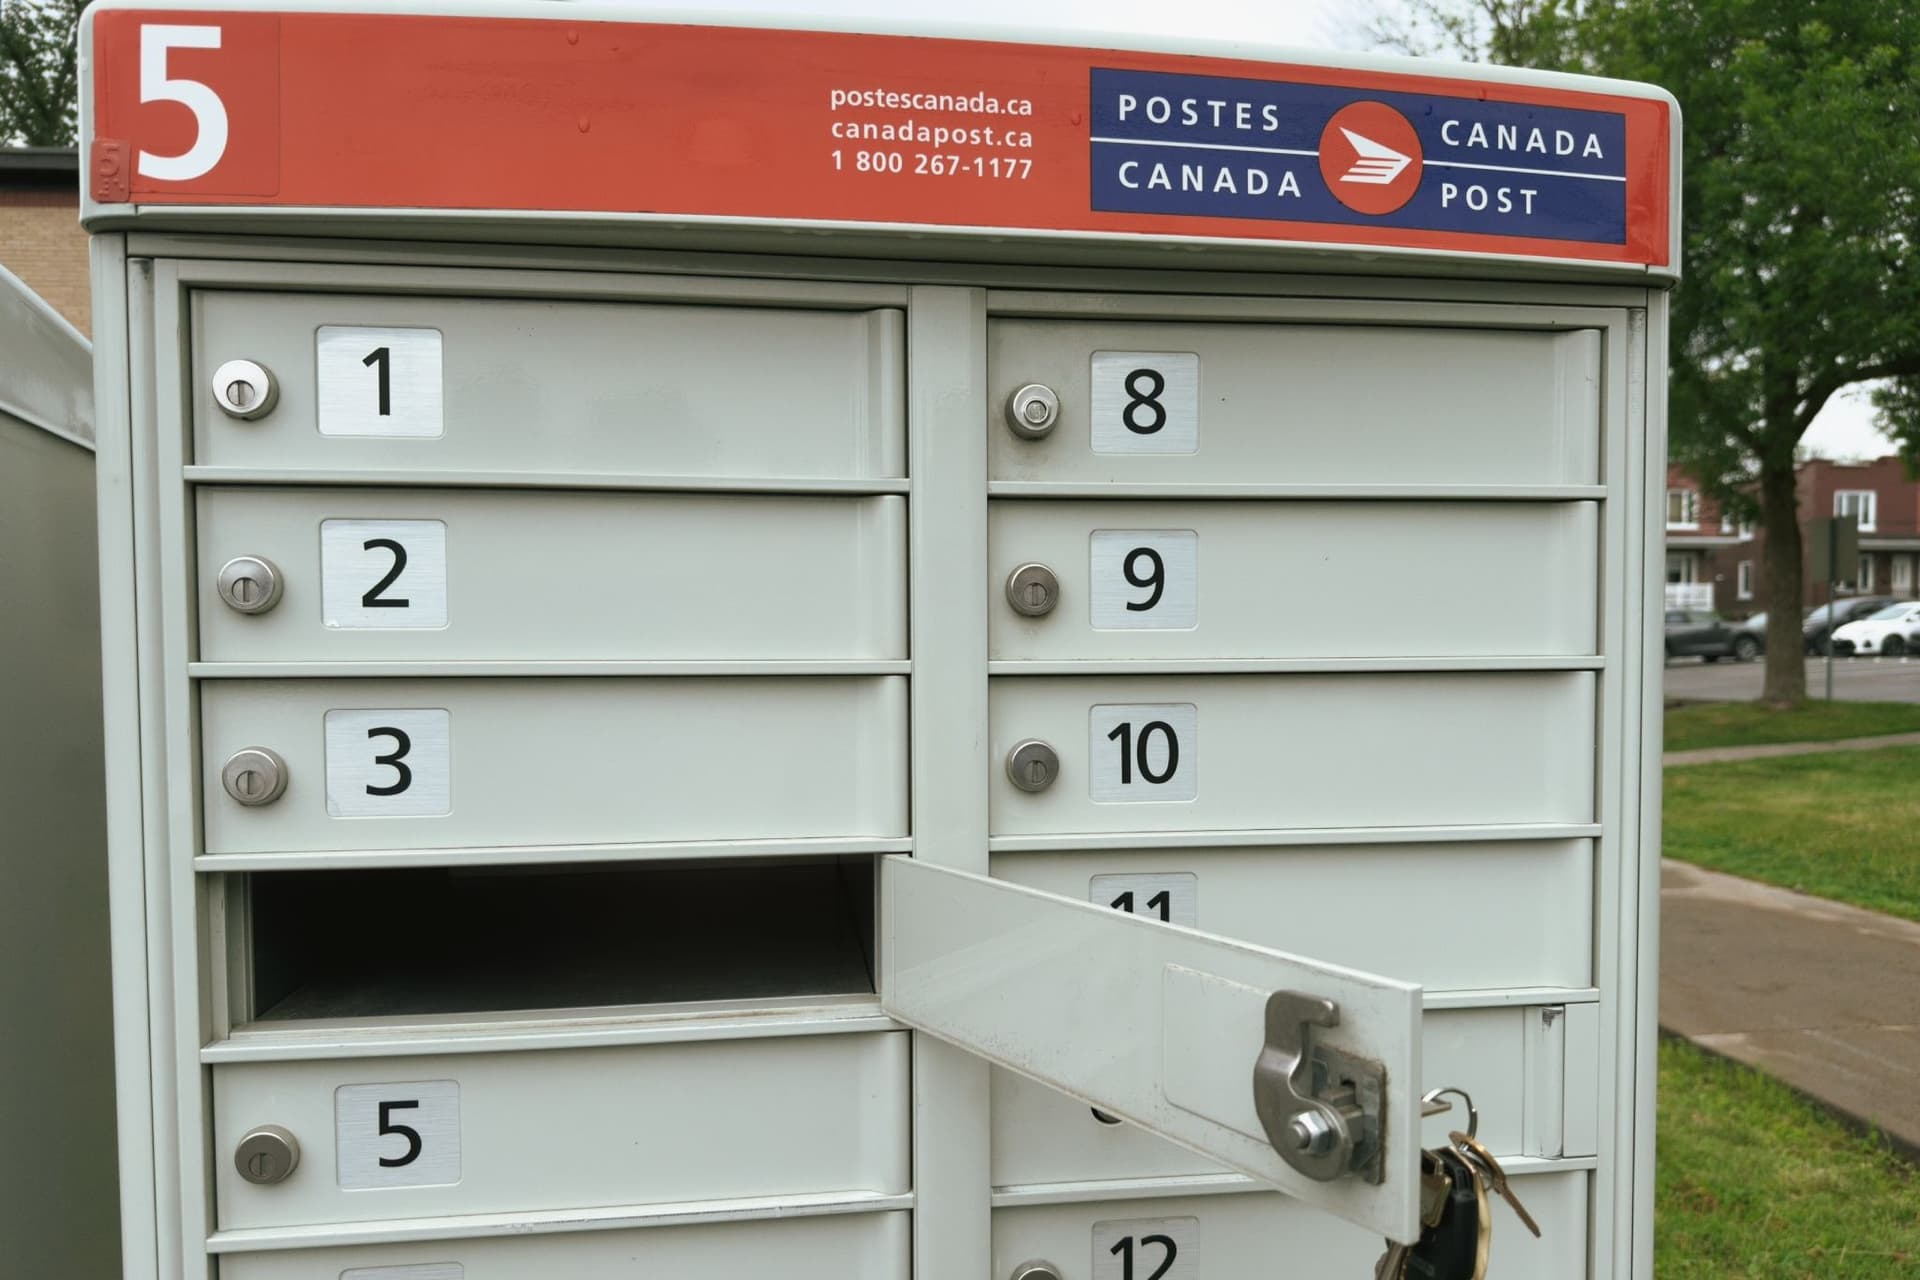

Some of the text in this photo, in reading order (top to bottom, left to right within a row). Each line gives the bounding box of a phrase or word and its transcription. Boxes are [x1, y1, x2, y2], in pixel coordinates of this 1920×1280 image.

[137, 24, 230, 182] 5
[831, 88, 1033, 116] postescanada.ca
[1119, 94, 1279, 132] POSTES
[831, 120, 1033, 149] canadapost.ca
[1441, 119, 1604, 159] CANADA
[831, 150, 1033, 180] 1 800 267-1177
[1118, 161, 1302, 198] CANADA
[1441, 183, 1539, 215] POST
[361, 347, 391, 416] 1
[1124, 369, 1167, 436] 8
[362, 539, 411, 609] 2
[1124, 548, 1166, 613] 9
[366, 727, 413, 798] 3
[1107, 720, 1180, 785] 10
[378, 1099, 423, 1169] 5
[1110, 1234, 1178, 1280] 12
